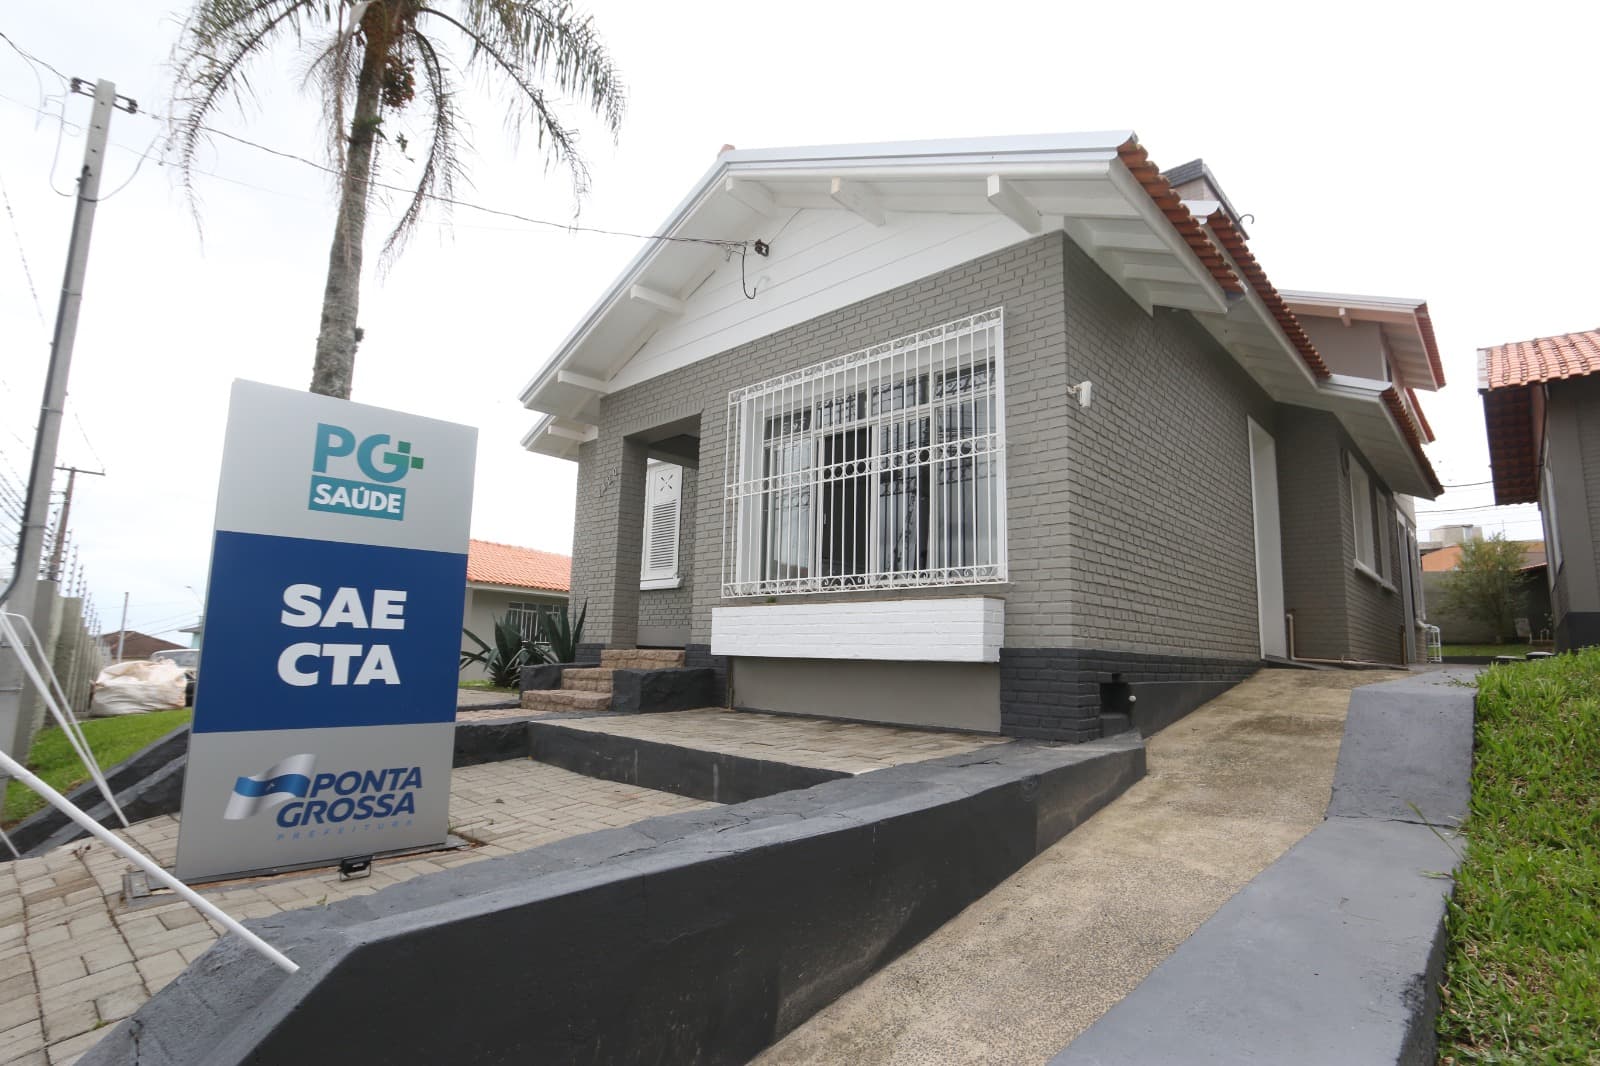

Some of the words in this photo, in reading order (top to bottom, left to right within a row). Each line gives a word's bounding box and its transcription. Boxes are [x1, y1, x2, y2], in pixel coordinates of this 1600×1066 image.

[313, 483, 402, 514] SAÚDE
[280, 583, 408, 630] SAE
[277, 642, 401, 687] CTA
[309, 766, 423, 798] PONTA
[276, 791, 416, 828] GROSSA
